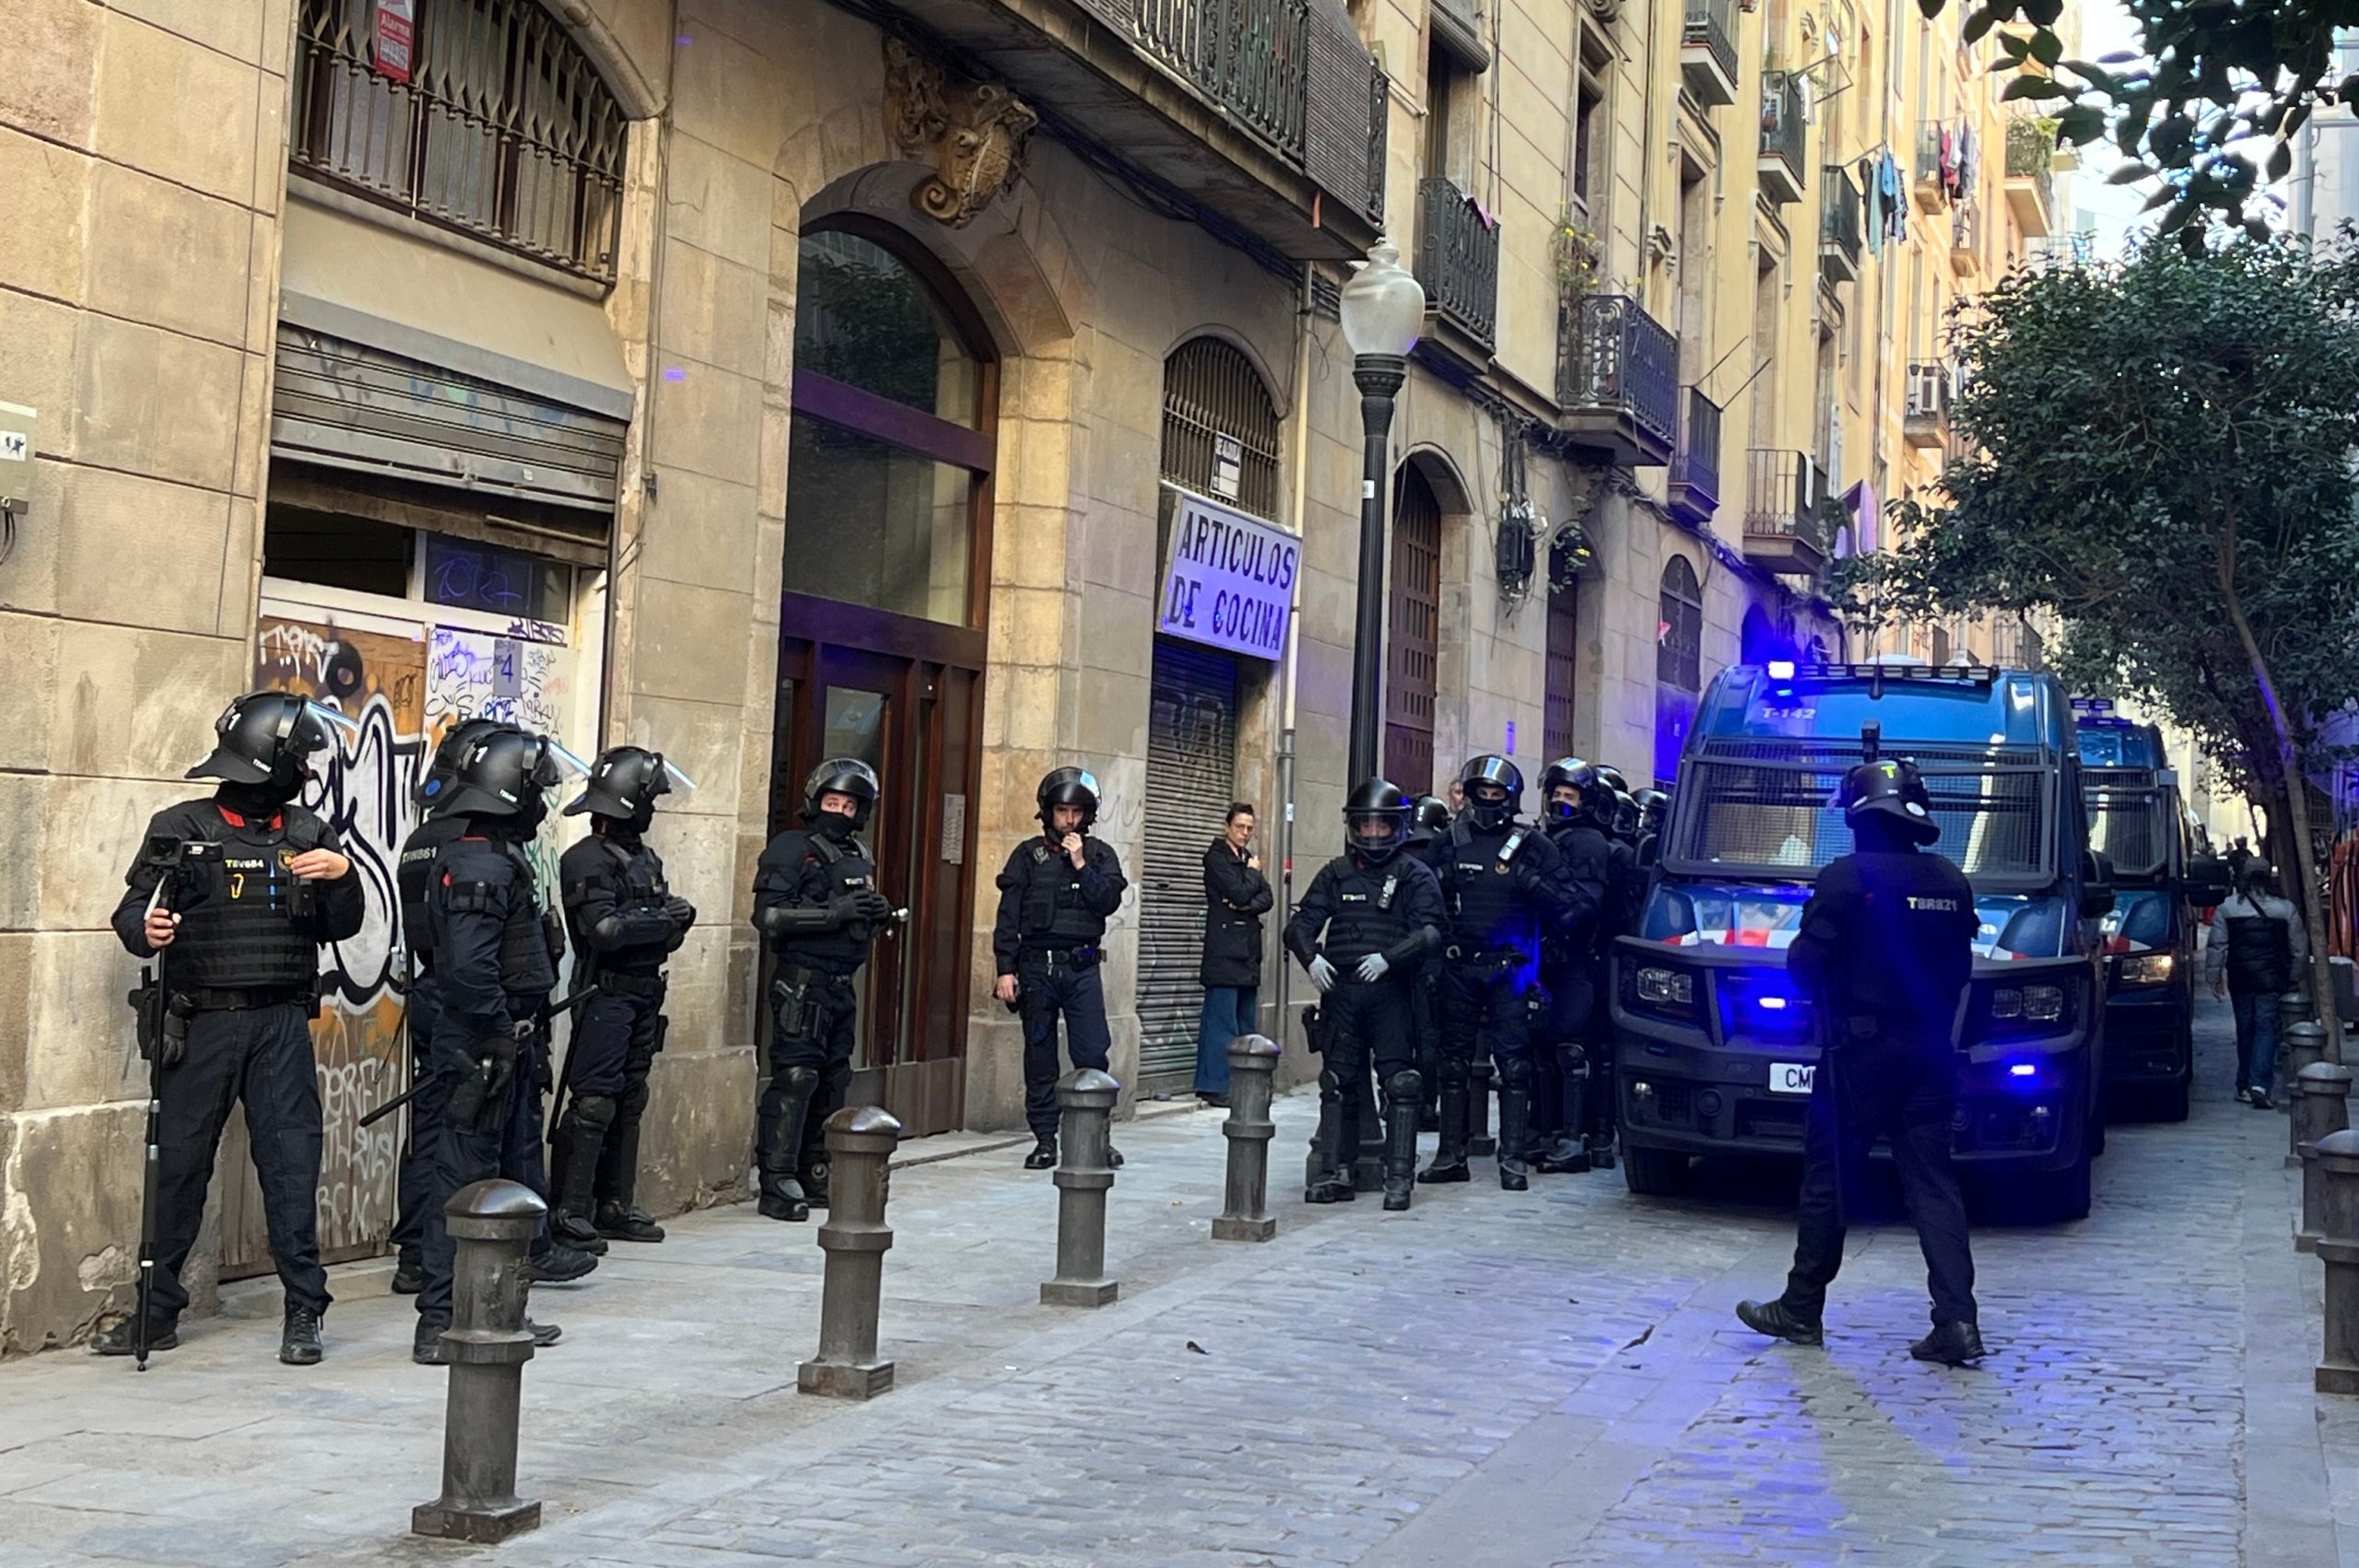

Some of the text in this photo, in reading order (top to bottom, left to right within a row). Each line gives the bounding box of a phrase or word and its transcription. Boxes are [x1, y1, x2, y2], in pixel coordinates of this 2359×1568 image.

[1178, 511, 1296, 591] ARTICULOS
[1168, 575, 1284, 651] DE COCINA
[1762, 707, 1816, 720] T-142
[1786, 1068, 1811, 1089] CM
